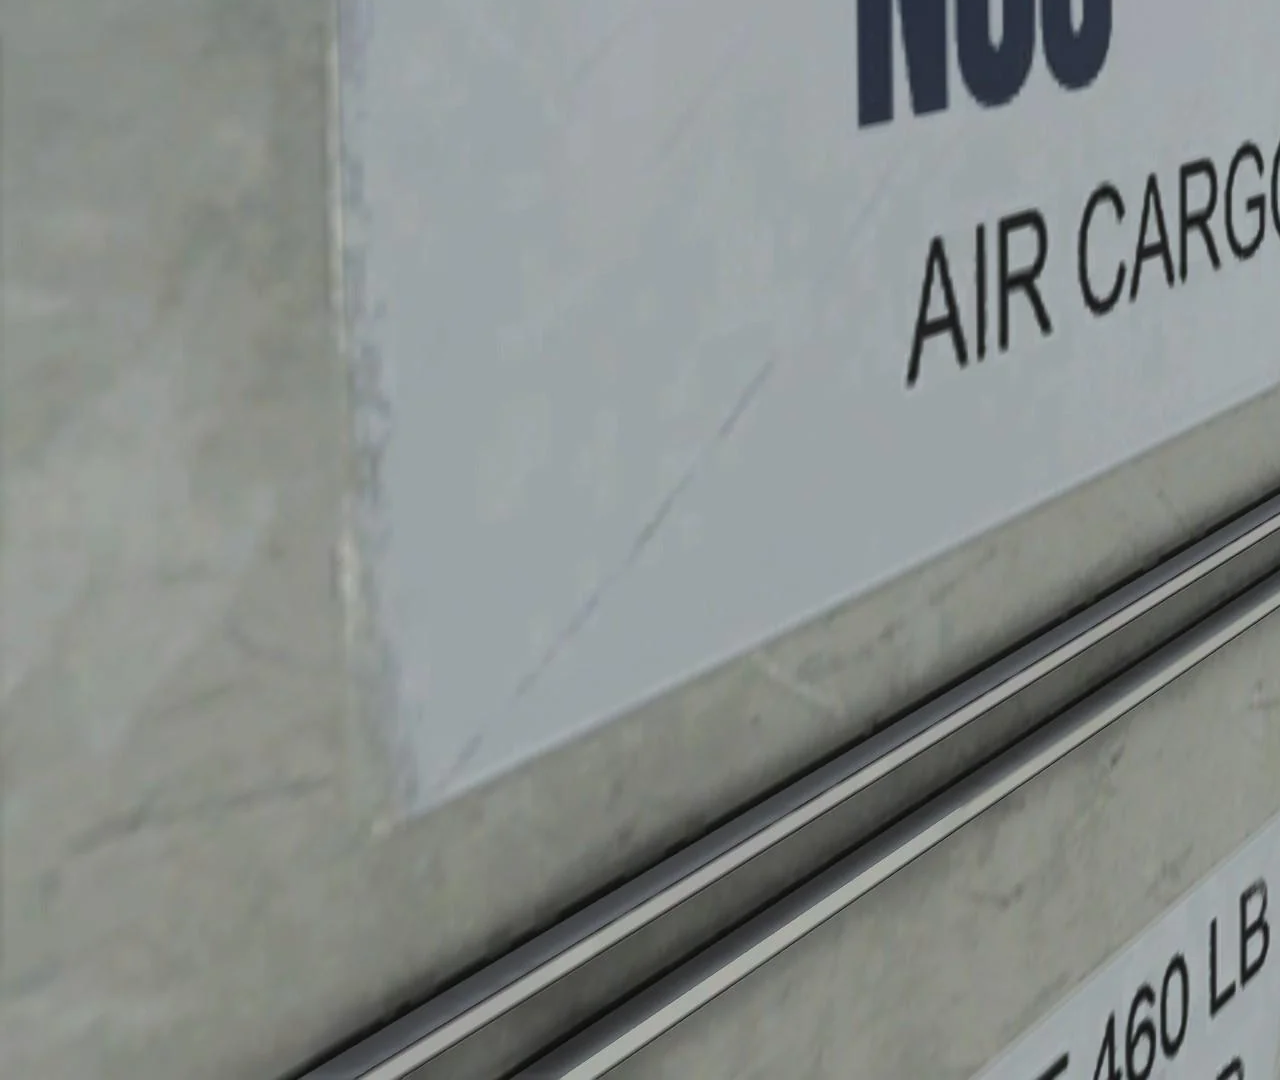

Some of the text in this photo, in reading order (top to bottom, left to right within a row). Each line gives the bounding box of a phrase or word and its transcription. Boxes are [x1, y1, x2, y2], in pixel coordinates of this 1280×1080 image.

[907, 206, 1053, 388] AIR
[1093, 875, 1270, 1080] 460 LB
